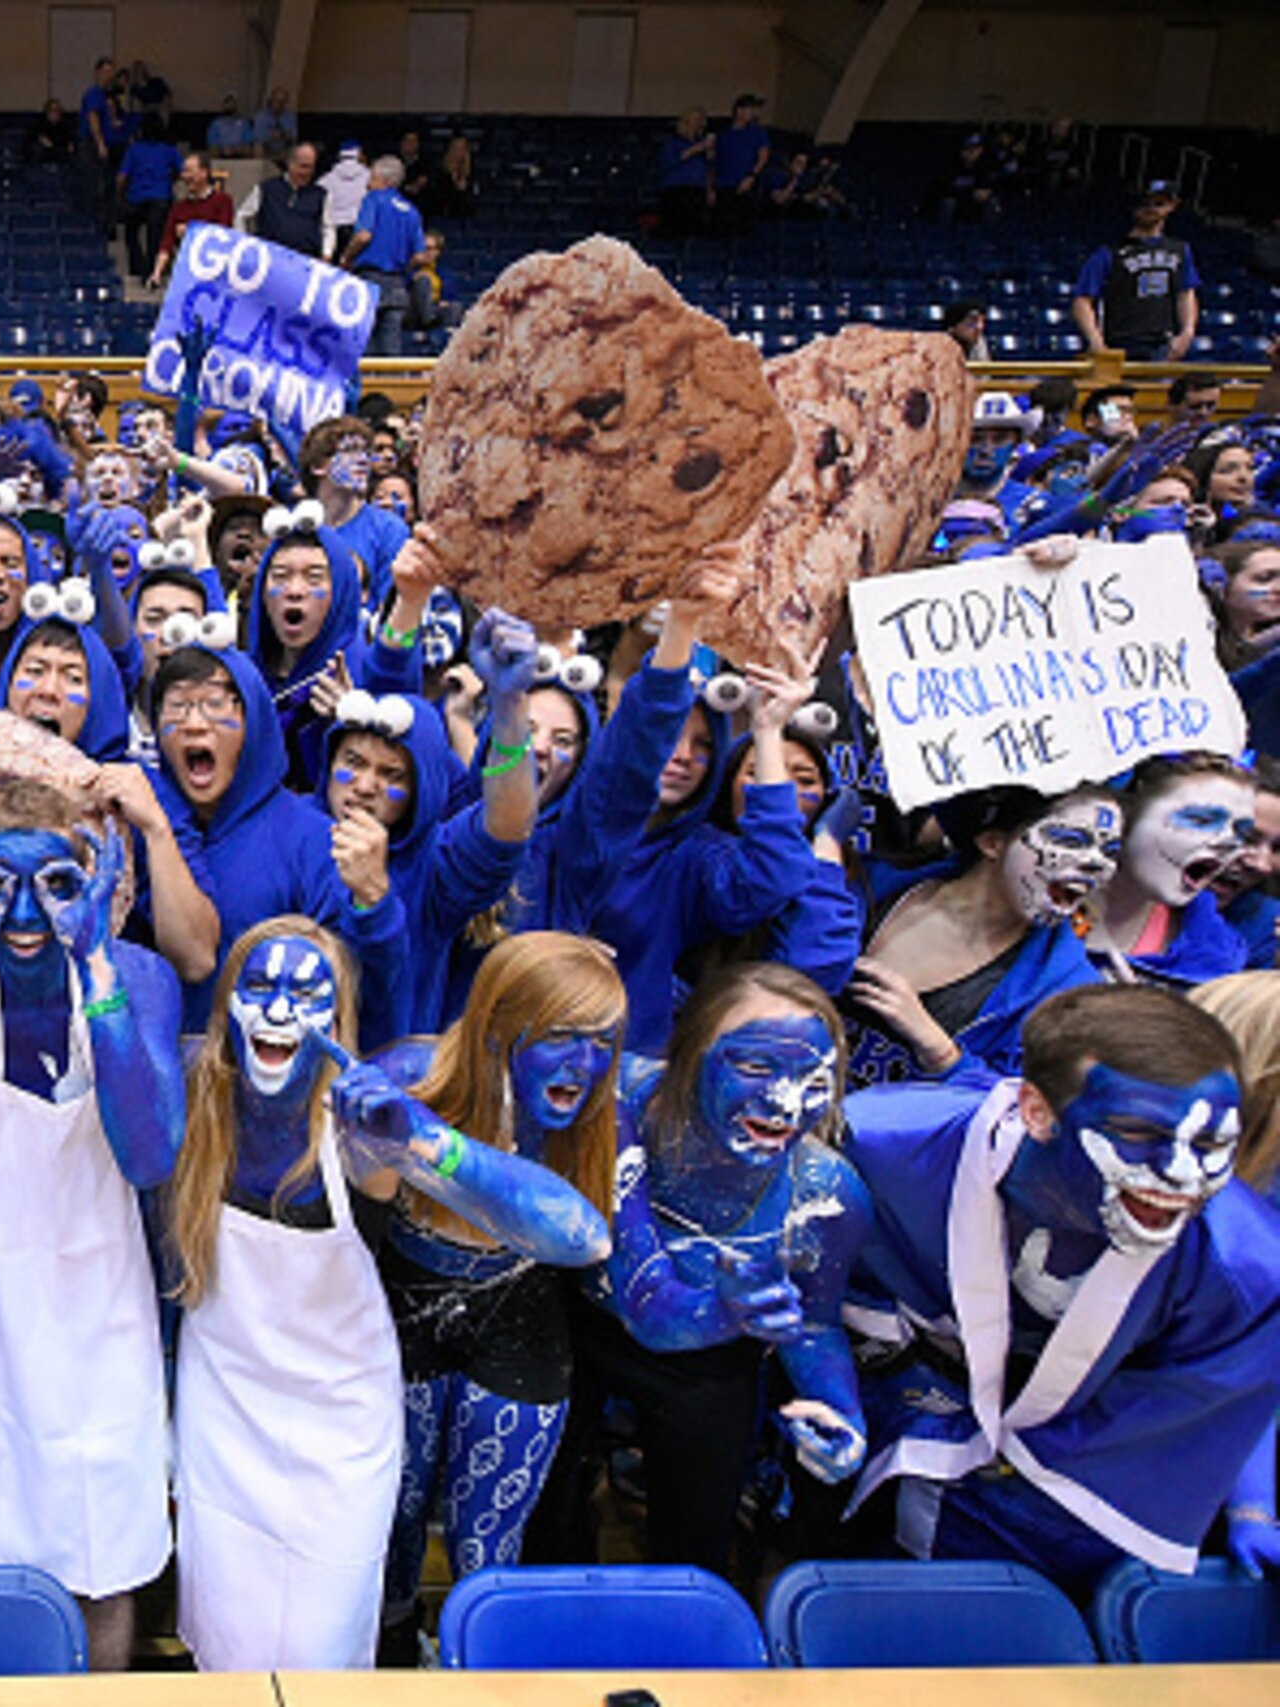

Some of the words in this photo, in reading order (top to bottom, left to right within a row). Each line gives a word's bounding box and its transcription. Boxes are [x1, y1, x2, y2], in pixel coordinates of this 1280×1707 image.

[189, 224, 271, 294] GO
[298, 257, 370, 329] TO
[181, 281, 342, 381] CLASS
[878, 579, 1058, 661] TODAY
[1081, 572, 1135, 633] IS
[885, 646, 1109, 726] CAROLINA'S
[1119, 638, 1189, 691] DAY
[918, 729, 968, 787] OF
[982, 713, 1070, 774] THE
[1102, 696, 1213, 757] DEAD
